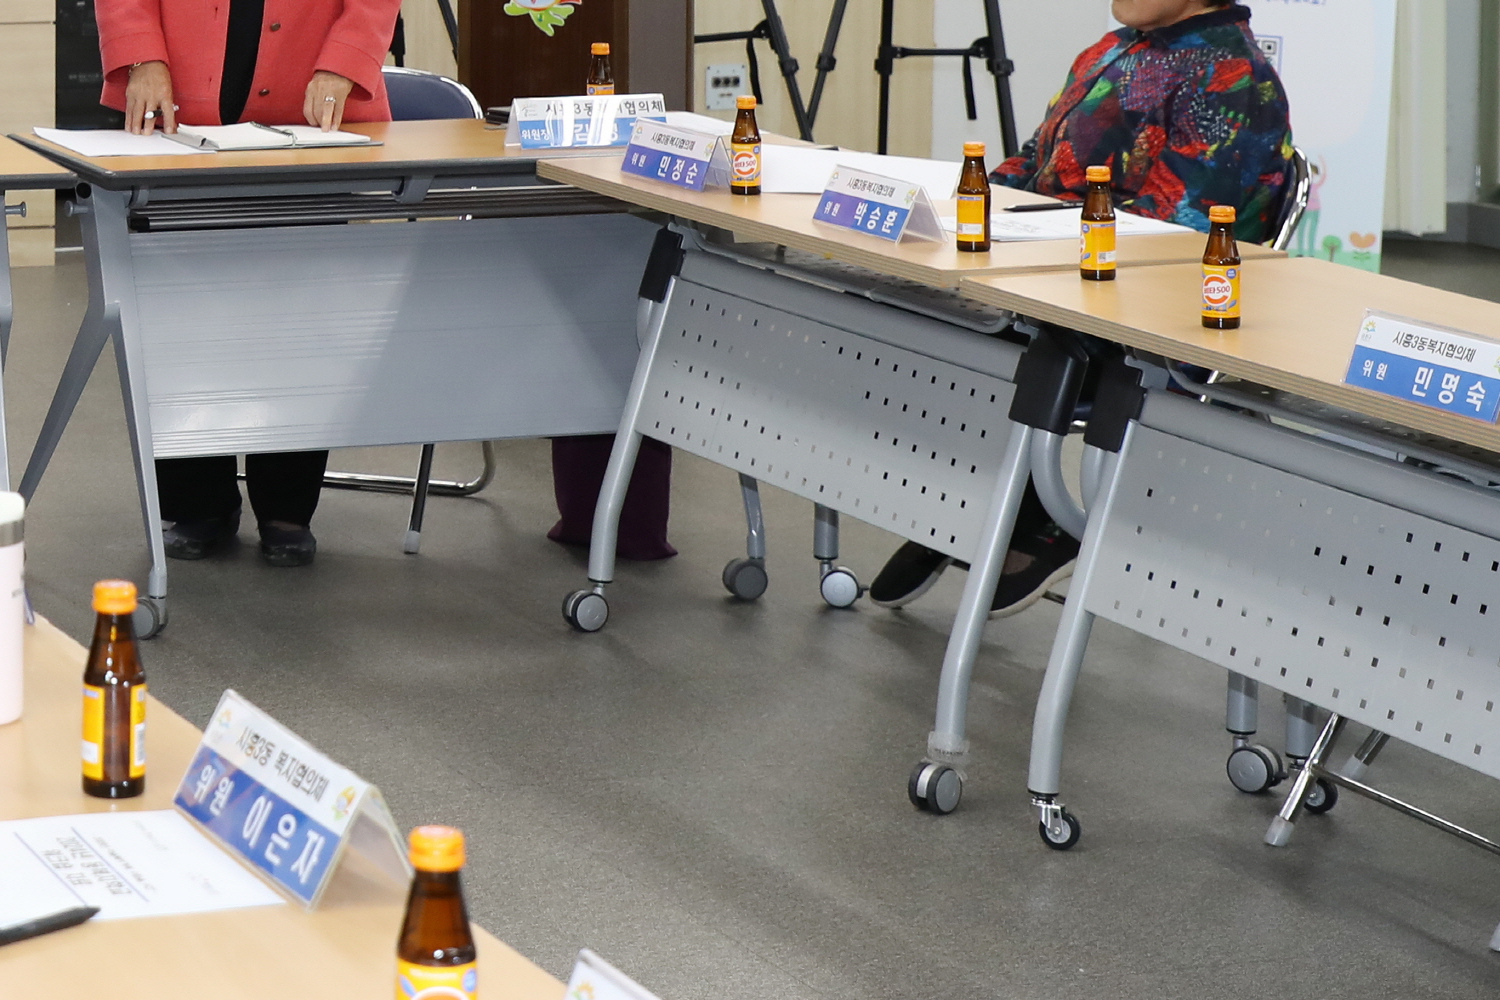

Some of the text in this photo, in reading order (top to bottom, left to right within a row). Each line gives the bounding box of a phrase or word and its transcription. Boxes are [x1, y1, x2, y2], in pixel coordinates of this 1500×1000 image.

[631, 152, 699, 185] 위원 민정순
[824, 201, 841, 217] 위원
[1392, 331, 1477, 363] 시흥3동복지협의체
[1362, 359, 1486, 412] 위원 민명숙
[236, 726, 330, 802] 시흥3동 복지협의체
[193, 764, 325, 884] 위원 이은자
